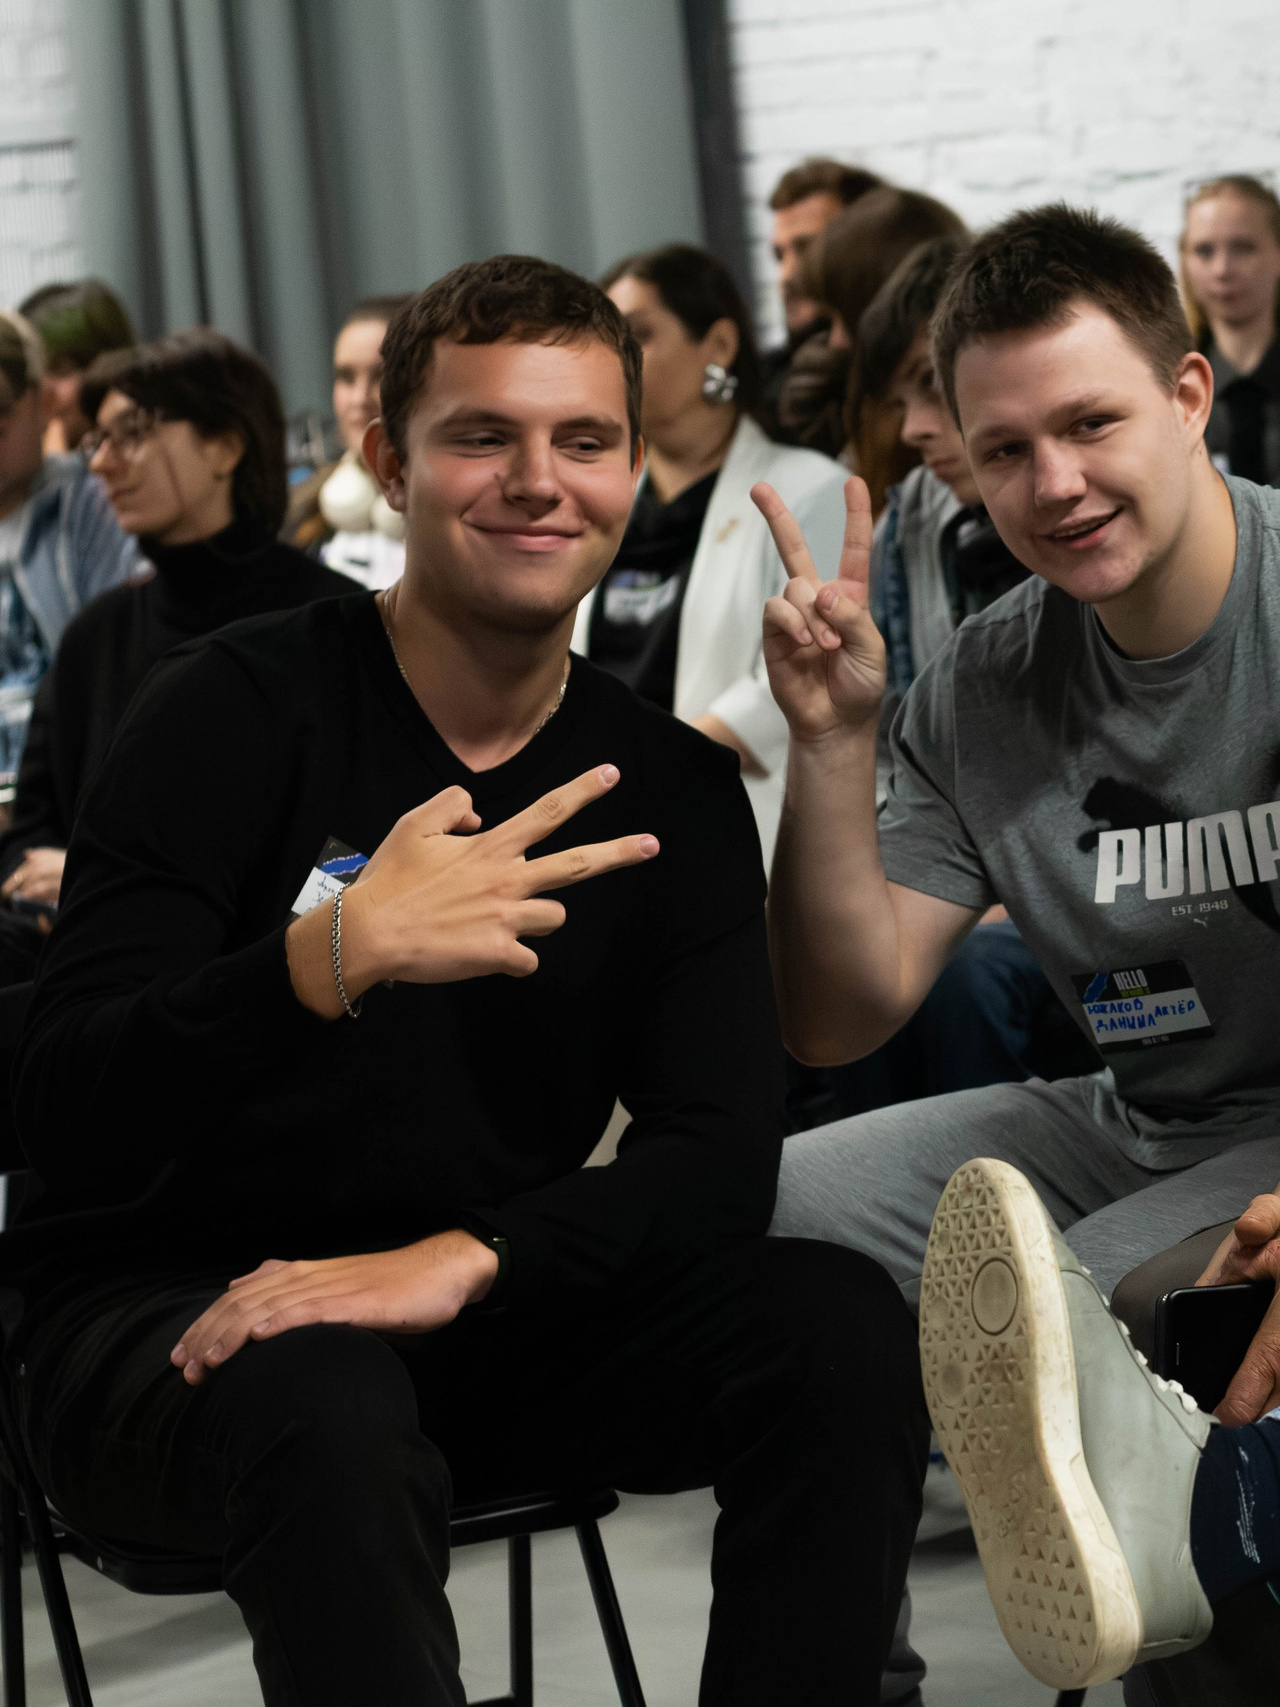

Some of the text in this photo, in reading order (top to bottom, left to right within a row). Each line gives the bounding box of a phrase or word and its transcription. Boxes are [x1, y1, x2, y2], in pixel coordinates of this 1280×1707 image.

[1199, 899, 1228, 913] 1948
[1113, 969, 1148, 991] HELLO
[1155, 1000, 1196, 1018] АКТЁР
